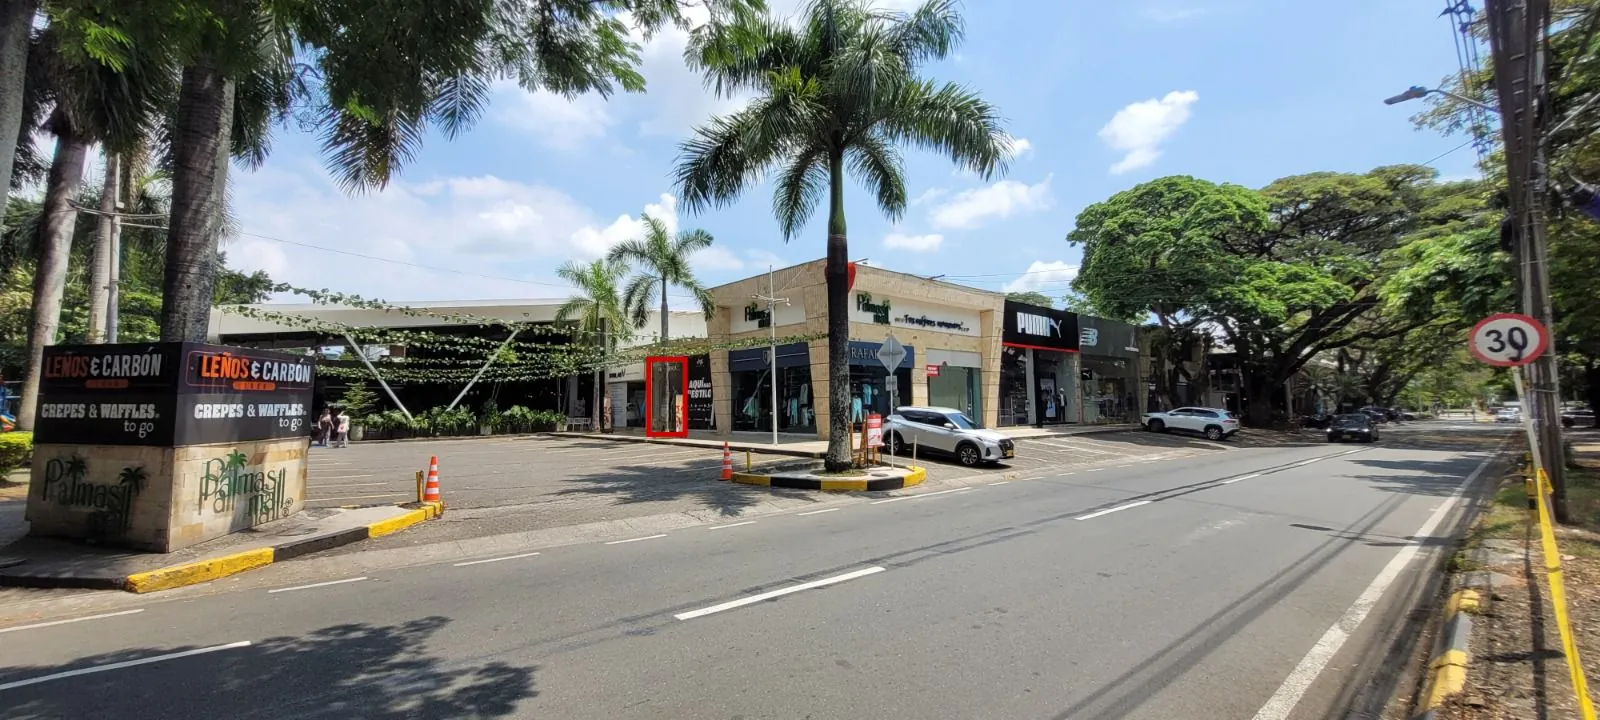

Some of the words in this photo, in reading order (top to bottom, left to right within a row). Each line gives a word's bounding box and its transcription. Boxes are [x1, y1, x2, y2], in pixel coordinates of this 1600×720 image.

[1016, 311, 1051, 337] PUMA
[102, 346, 162, 377] CARBÓN
[201, 351, 250, 379] LEÑOS
[262, 358, 311, 383] CARBÓN
[41, 403, 86, 418] CREPES
[88, 403, 98, 418] &
[100, 403, 156, 419] WAFFLES
[194, 403, 243, 419] CREPES
[247, 403, 256, 418] &
[258, 403, 304, 417] WAFFLES
[124, 420, 137, 432] to
[138, 421, 154, 438] go
[279, 418, 289, 428] to
[290, 417, 303, 432] go
[43, 456, 124, 509] Palmas
[202, 451, 277, 501] Palmas
